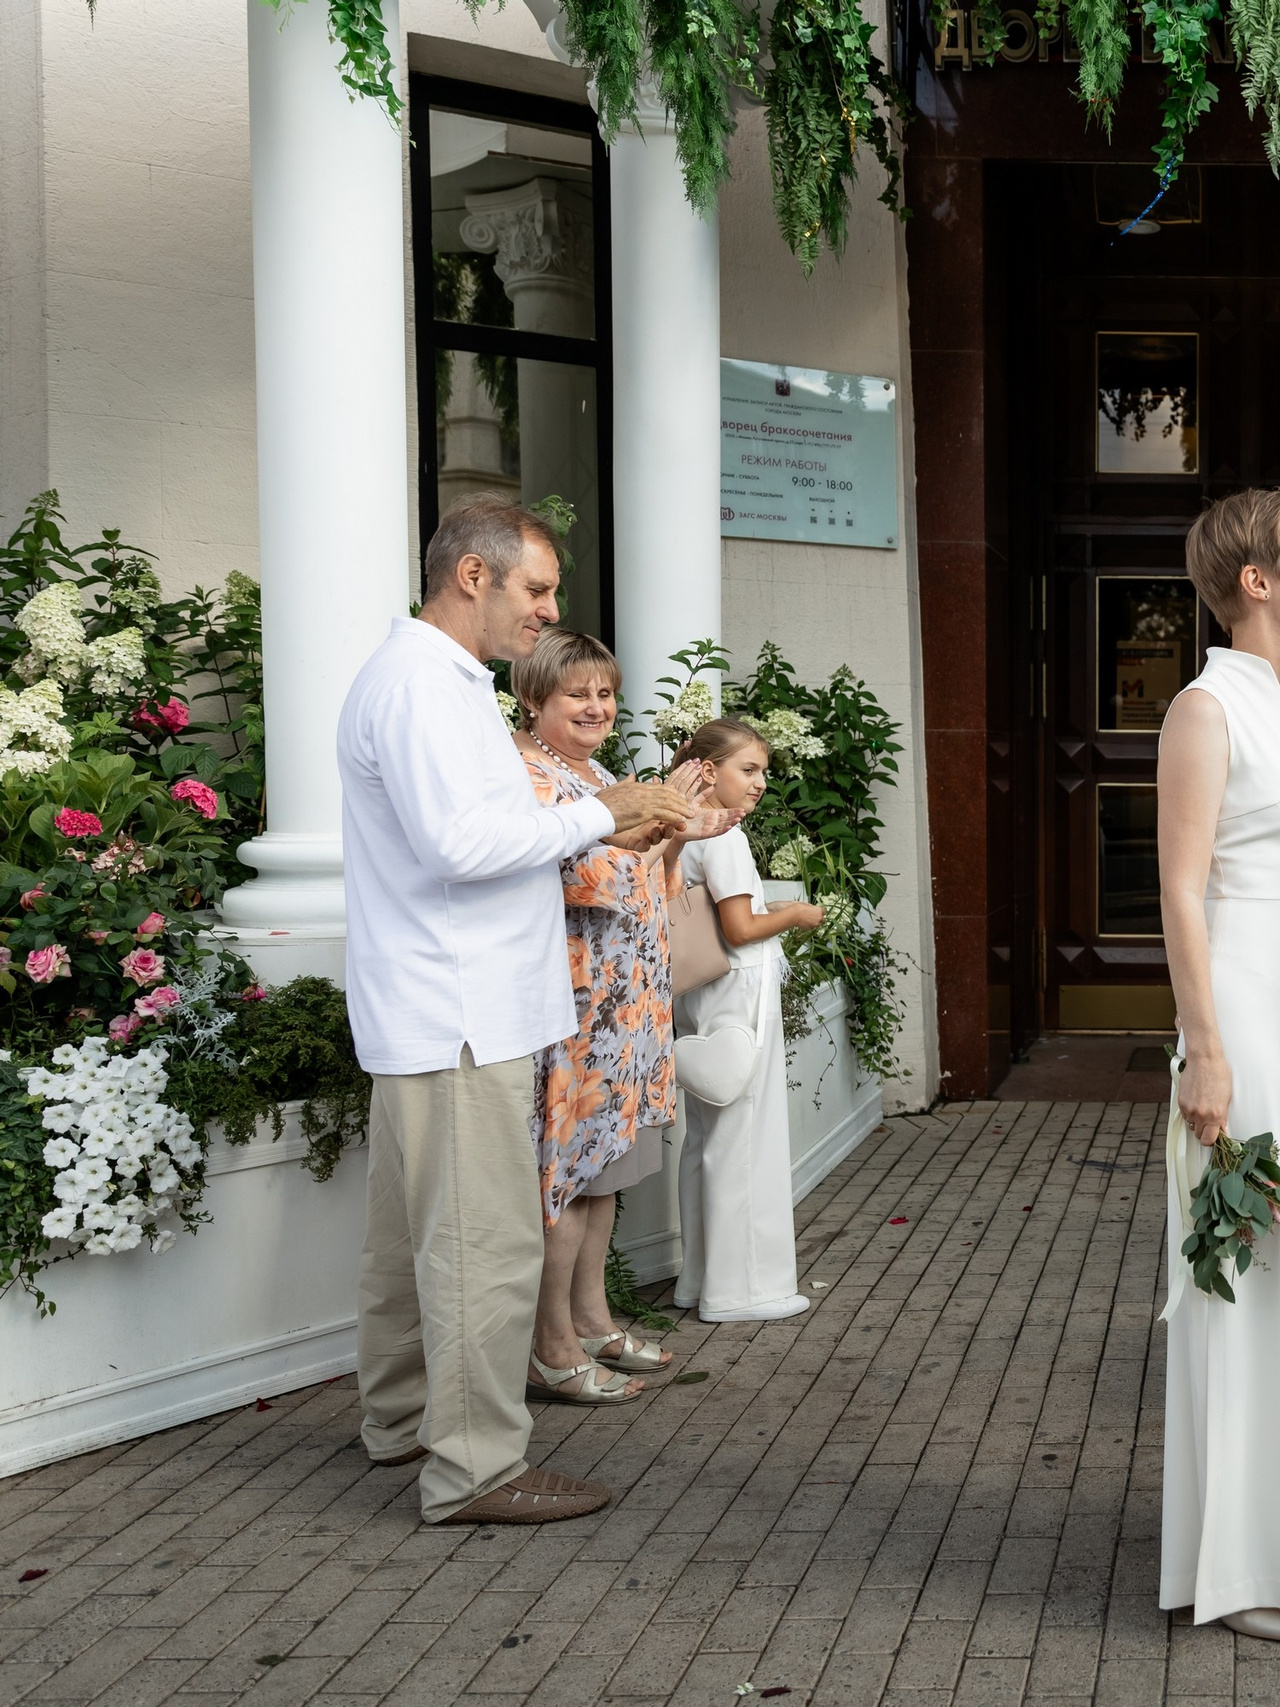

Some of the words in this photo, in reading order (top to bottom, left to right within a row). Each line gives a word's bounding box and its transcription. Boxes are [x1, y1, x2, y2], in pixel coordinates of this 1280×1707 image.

[934, 8, 1083, 71] ДВОРЕ
[760, 421, 853, 442] бракосочетания
[741, 454, 782, 468] РЕЖИМ
[785, 459, 827, 472] РАБОТЫ
[791, 476, 815, 488] 9:00
[826, 479, 853, 491] 18:00
[756, 513, 787, 521] МОСКВЫ
